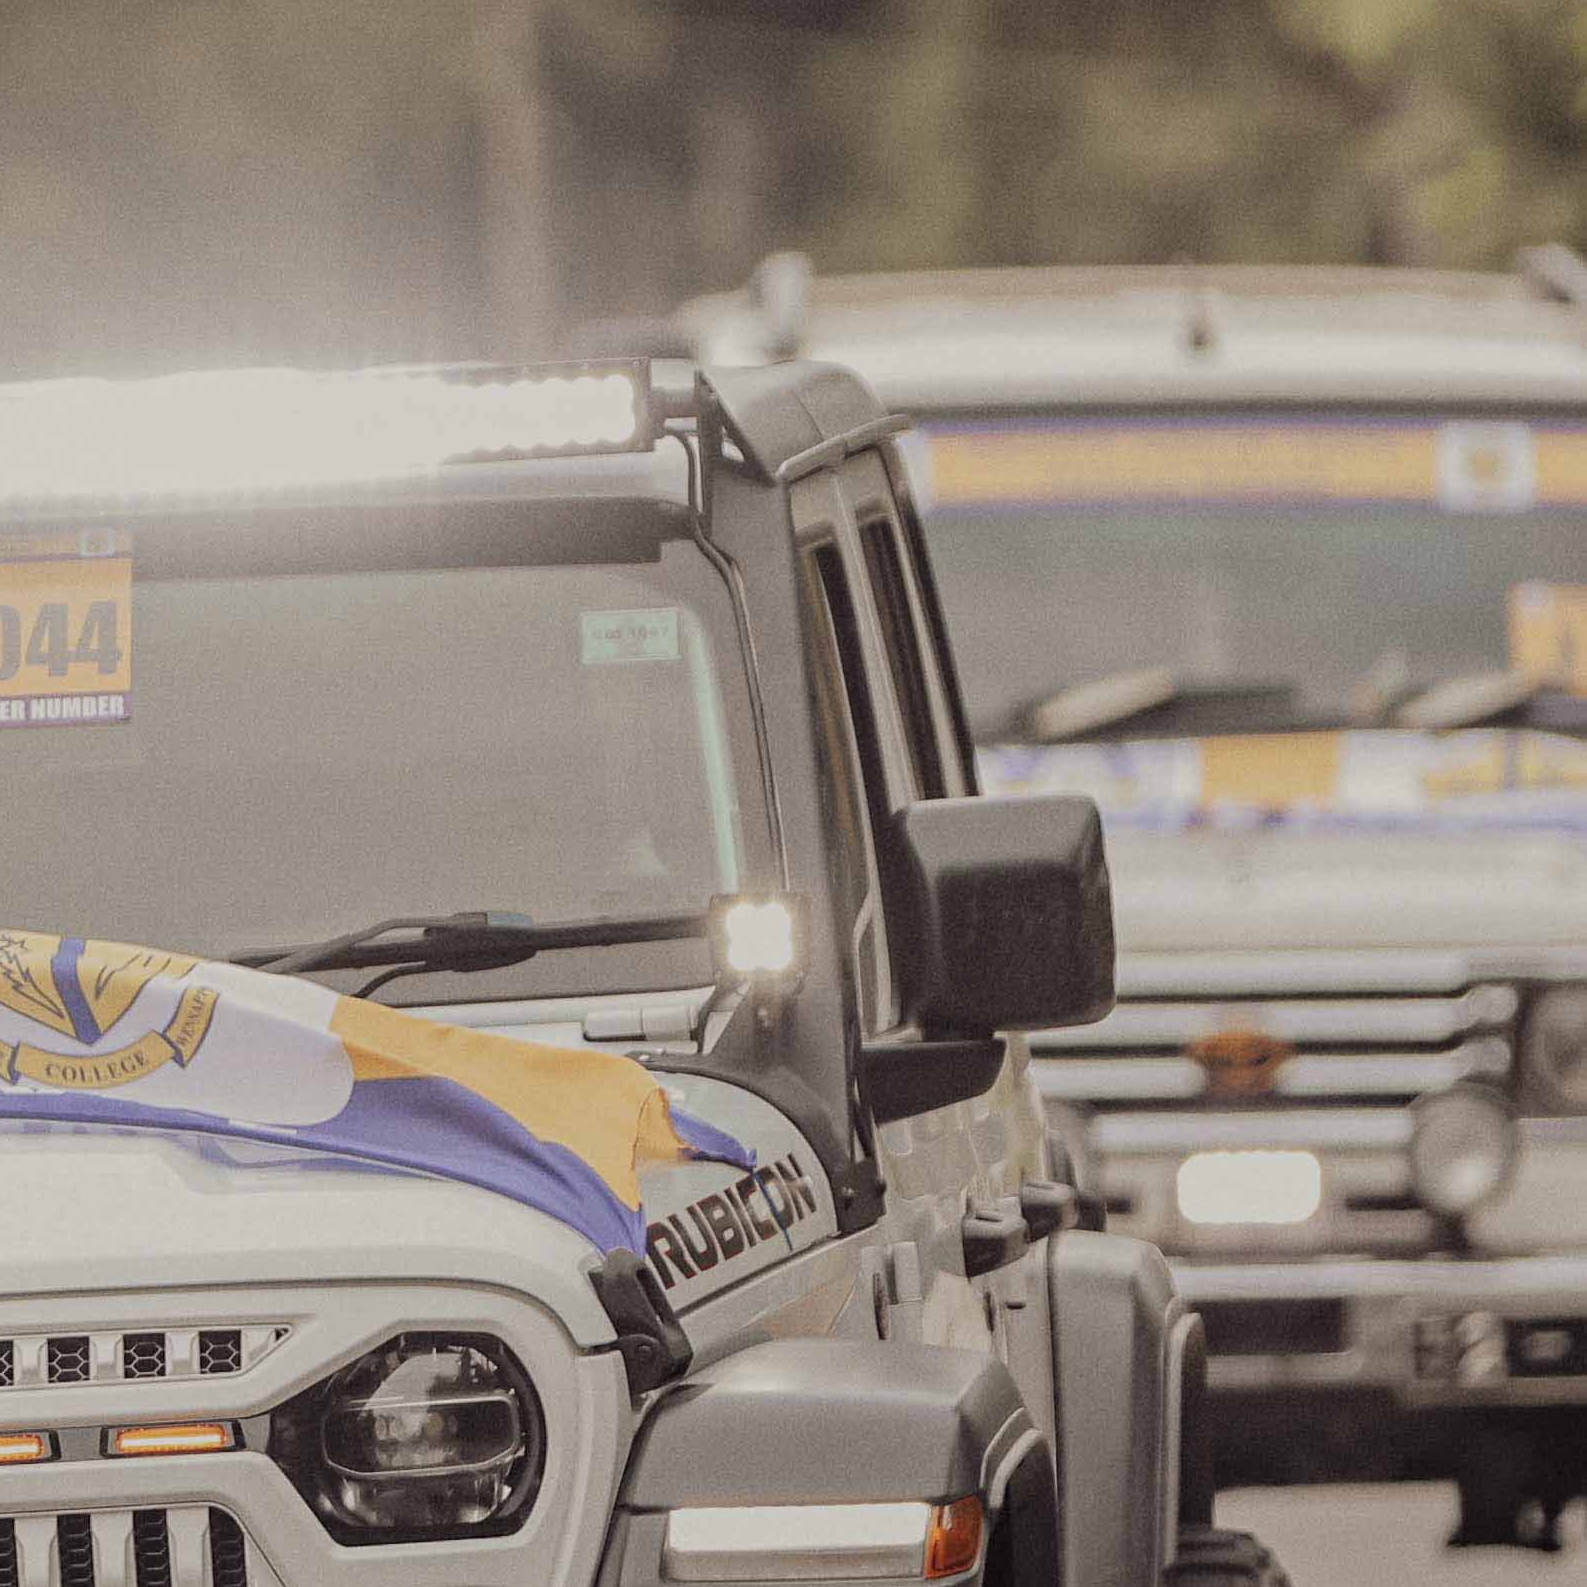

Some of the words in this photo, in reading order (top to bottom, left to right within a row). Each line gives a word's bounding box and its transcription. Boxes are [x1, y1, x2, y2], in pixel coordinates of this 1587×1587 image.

[30, 694, 125, 720] NUMBER
[44, 1050, 150, 1083] COLLEGE
[646, 1152, 817, 1291] RUBICON
